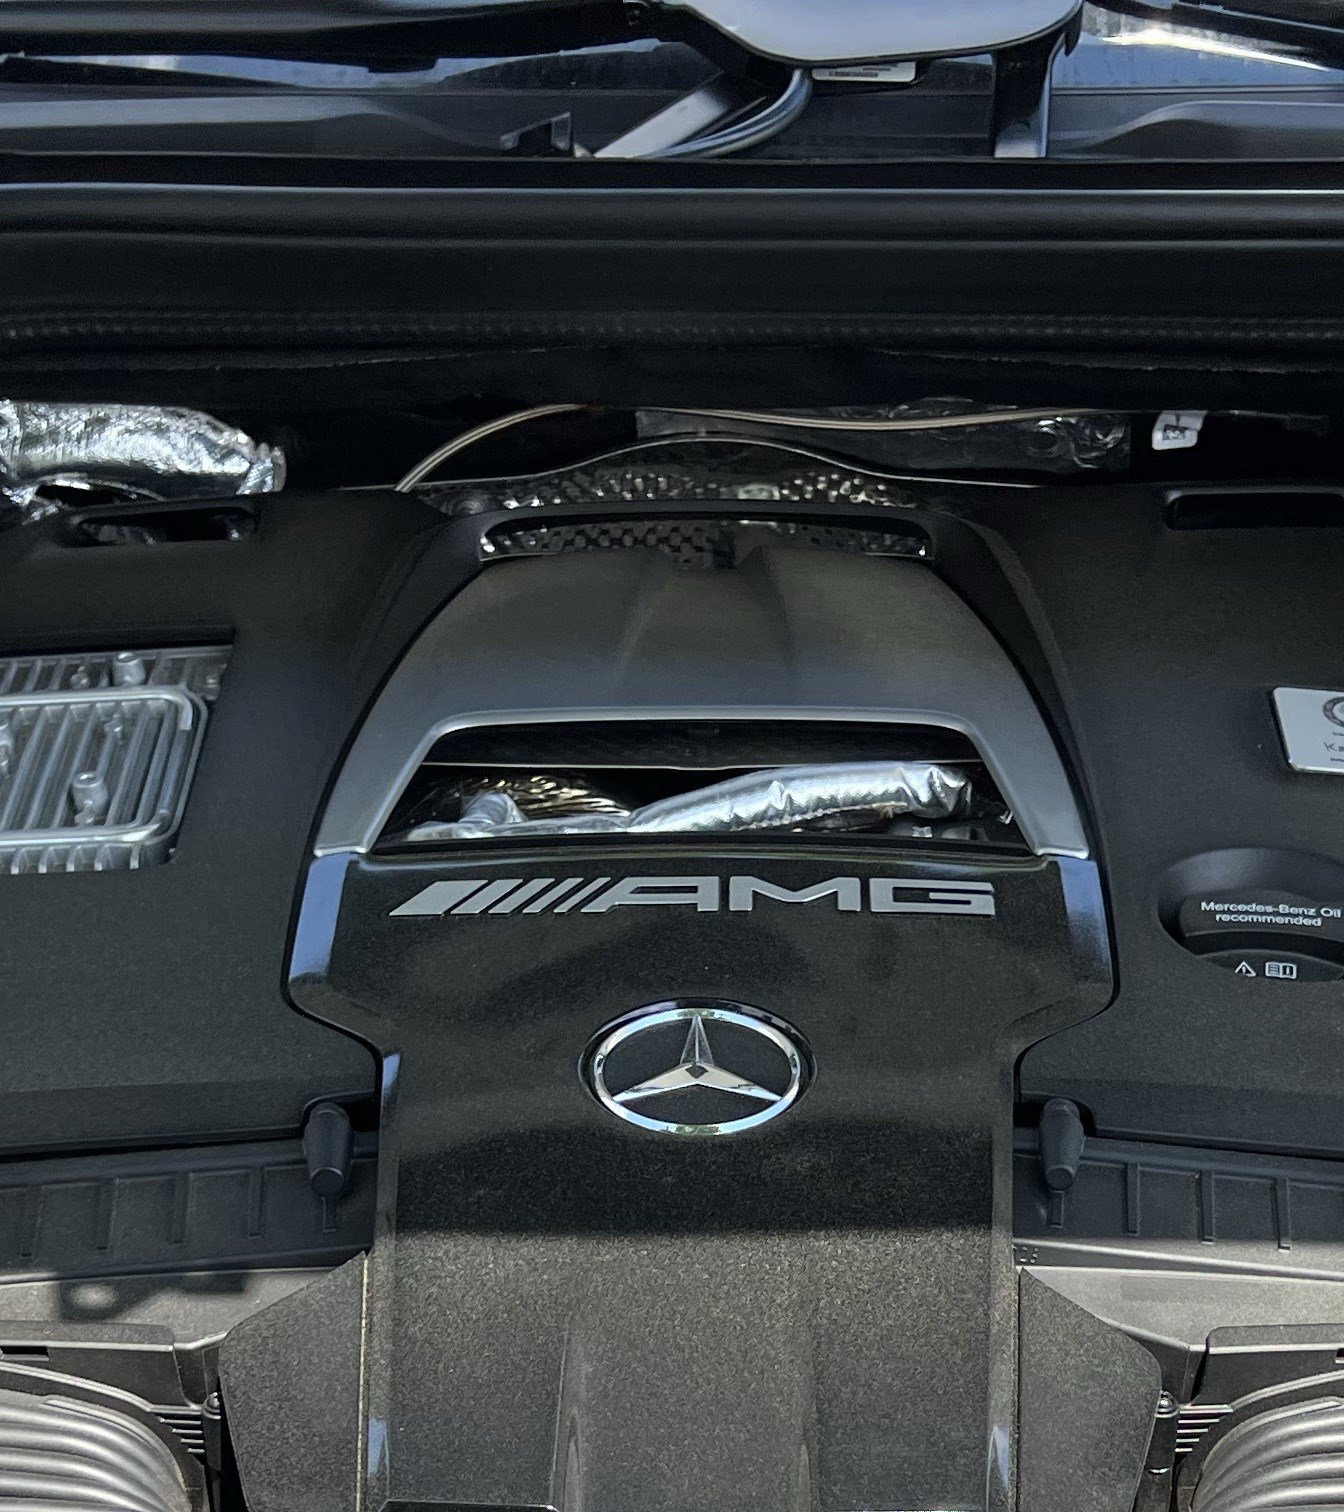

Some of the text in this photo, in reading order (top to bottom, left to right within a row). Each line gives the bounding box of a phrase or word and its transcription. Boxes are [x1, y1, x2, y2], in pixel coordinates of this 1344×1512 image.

[580, 875, 996, 916] AMG
[1200, 901, 1342, 918] Mercedes-Benz Oil
[1215, 913, 1323, 927] recommended
